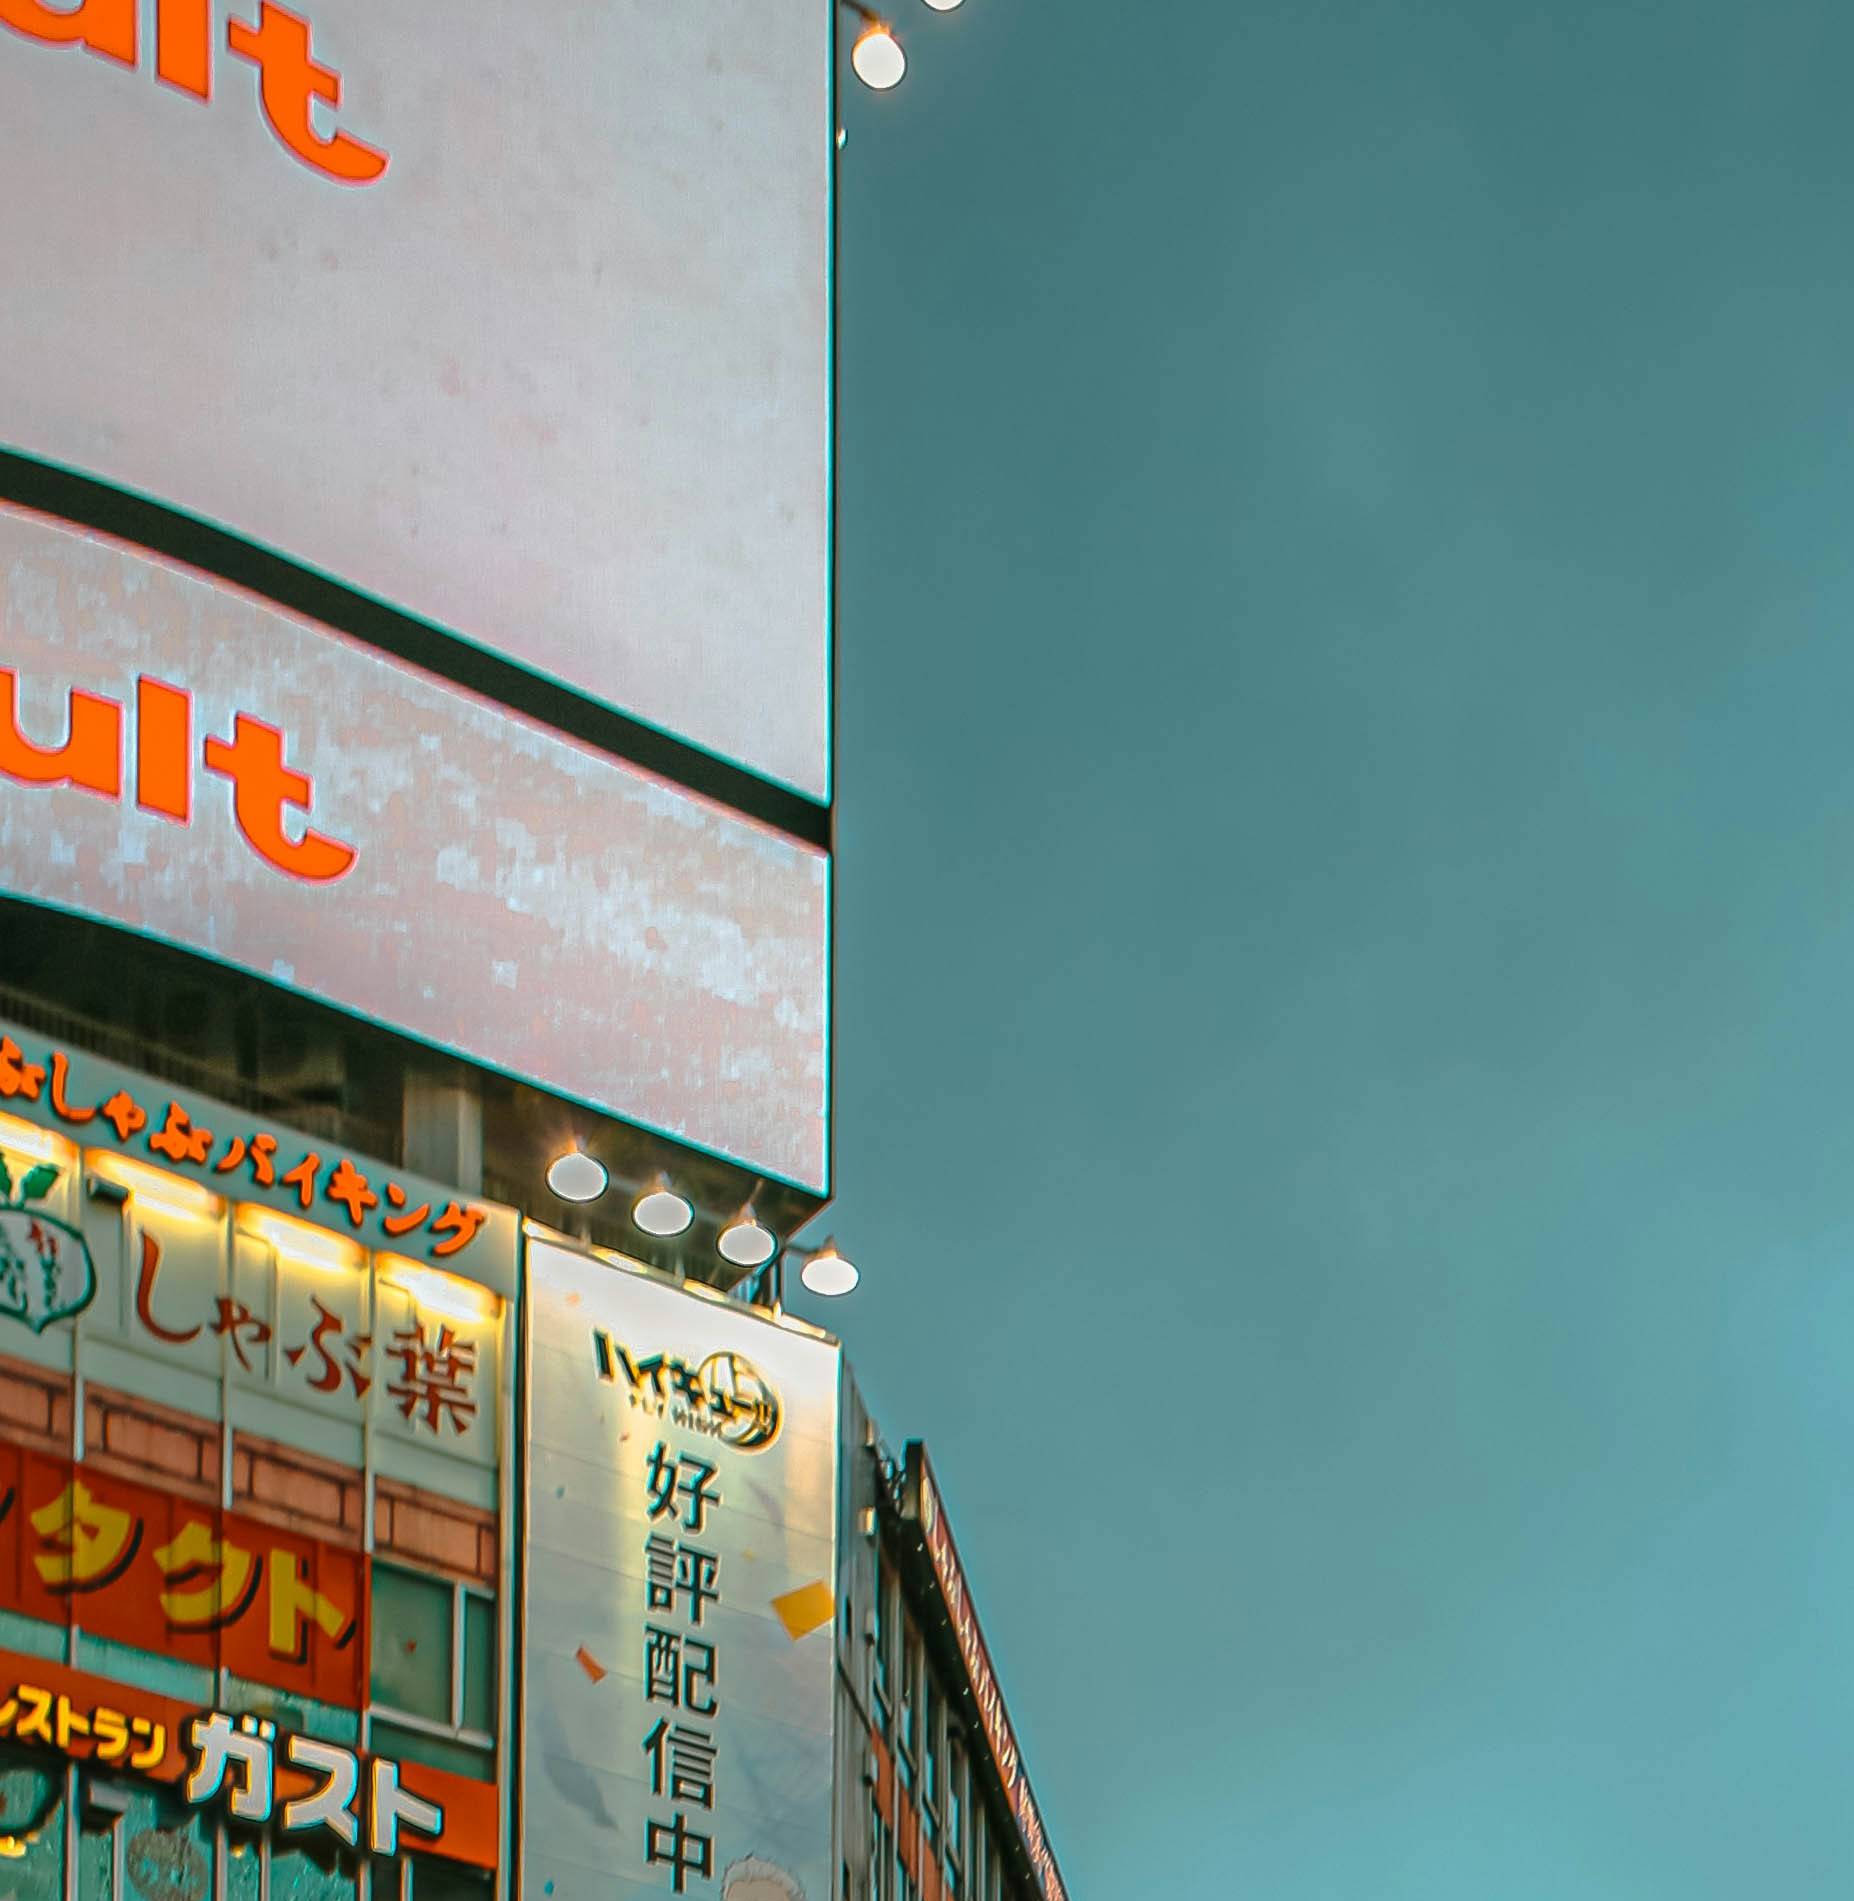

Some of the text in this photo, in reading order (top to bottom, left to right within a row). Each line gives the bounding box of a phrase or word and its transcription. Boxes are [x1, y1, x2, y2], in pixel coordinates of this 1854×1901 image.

[135, 1230, 478, 1436] しゃぶ葉
[187, 1711, 444, 1857] ガスト
